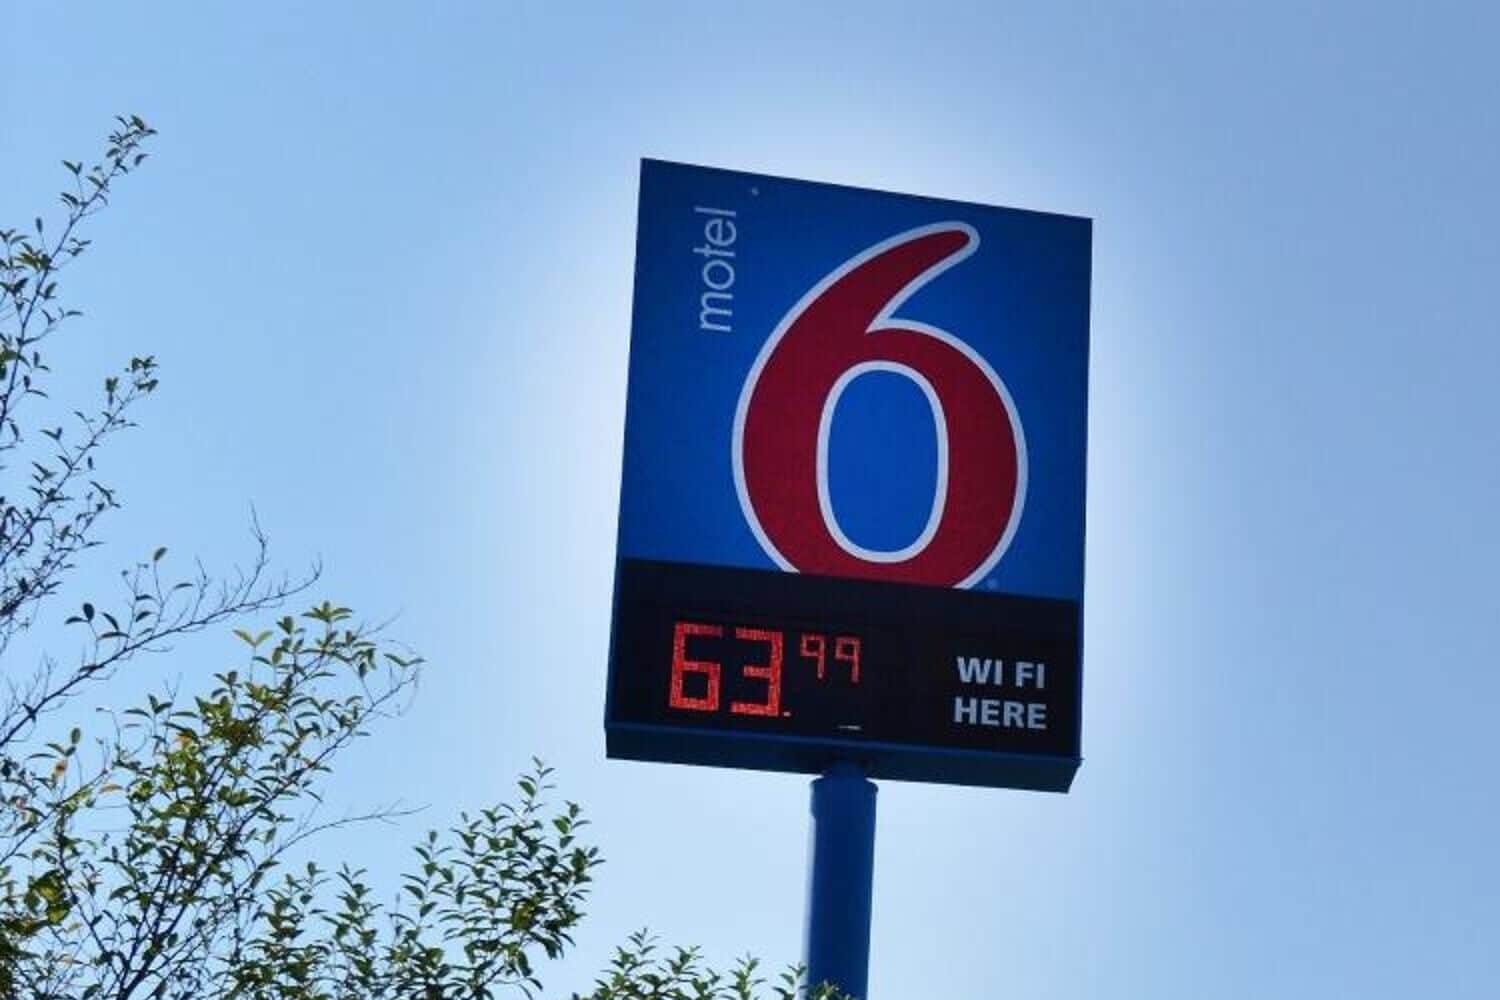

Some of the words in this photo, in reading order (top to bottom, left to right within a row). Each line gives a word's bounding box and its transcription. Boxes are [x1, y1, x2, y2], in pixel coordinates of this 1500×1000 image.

[693, 206, 737, 333] motel
[731, 220, 1029, 590] 6
[953, 696, 1048, 731] HERE
[956, 656, 1003, 685] WI
[1014, 660, 1046, 690] FI
